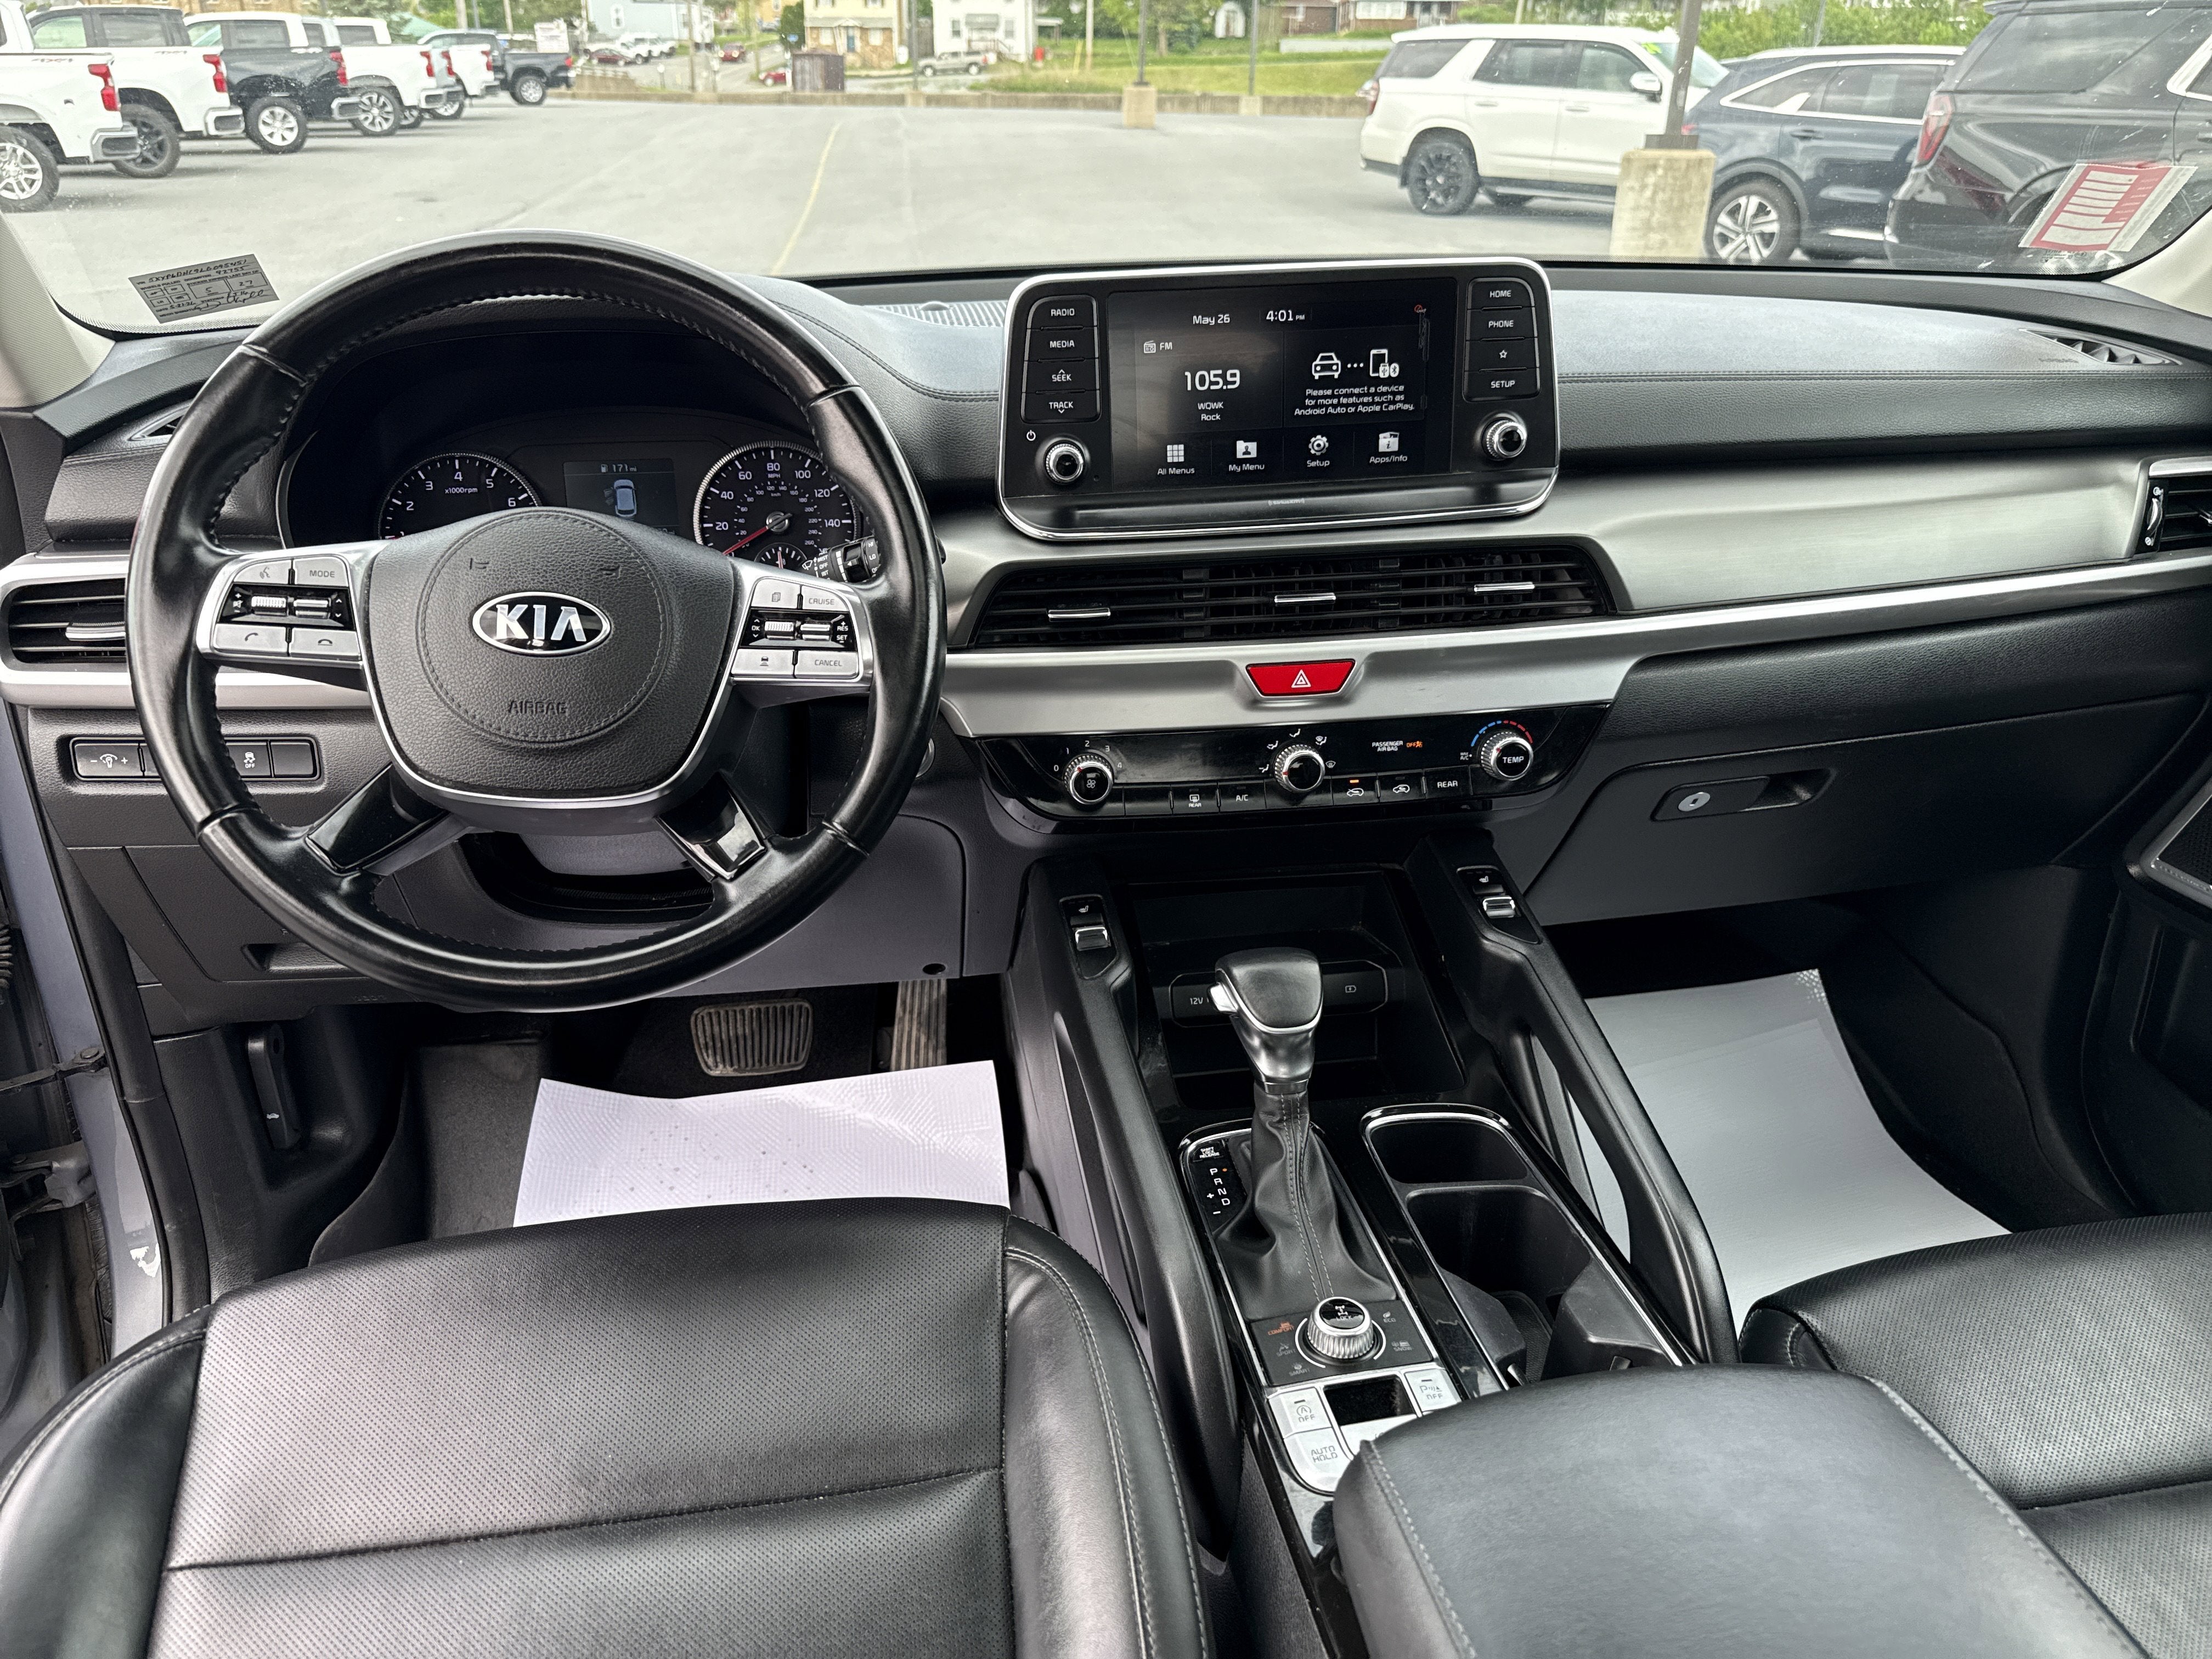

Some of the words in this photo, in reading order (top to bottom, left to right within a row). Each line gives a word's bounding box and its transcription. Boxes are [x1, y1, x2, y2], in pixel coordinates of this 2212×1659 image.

[1051, 308, 1075, 317] RADIO
[1266, 309, 1294, 322] 4:01
[1192, 314, 1215, 325] May
[1217, 314, 1231, 324] 26
[1049, 340, 1075, 348] MEDIA
[1159, 342, 1173, 351] FM
[1052, 374, 1072, 382] SEEK
[1184, 369, 1240, 391] 105.9
[1491, 380, 1515, 388] SETUP
[1334, 386, 1367, 395] connect
[1376, 385, 1404, 393] device
[1048, 400, 1074, 409] TRACK
[1305, 398, 1317, 406] for
[1340, 396, 1373, 404] features
[1198, 402, 1224, 410] WQWK
[1294, 407, 1325, 416] Android
[1327, 406, 1346, 414] Auto
[1357, 403, 1381, 413] Apple
[1382, 403, 1415, 411] CarPlay.
[1201, 413, 1221, 421] Rock
[1307, 459, 1330, 467] Setup
[1369, 454, 1408, 464] Apps/Info
[612, 464, 628, 472] 171
[767, 463, 780, 471] 80
[1228, 463, 1241, 472] My
[454, 471, 463, 482] 4
[738, 471, 752, 481] 60
[795, 470, 811, 479] 100
[426, 481, 433, 490] 3
[486, 478, 494, 489] 5
[720, 491, 734, 500] 40
[814, 488, 831, 498] 120
[406, 501, 415, 511] 2
[508, 498, 516, 507] 6
[715, 521, 729, 531] 20
[824, 518, 841, 527] 140
[495, 604, 586, 642] KIA
[509, 701, 567, 714] AIRBAG
[1502, 756, 1525, 764] TEMP
[1267, 1325, 1294, 1335] COMFORT
[1299, 1414, 1315, 1423] OFF
[1311, 1445, 1335, 1455] AUTO
[1313, 1453, 1338, 1463] HOLD
